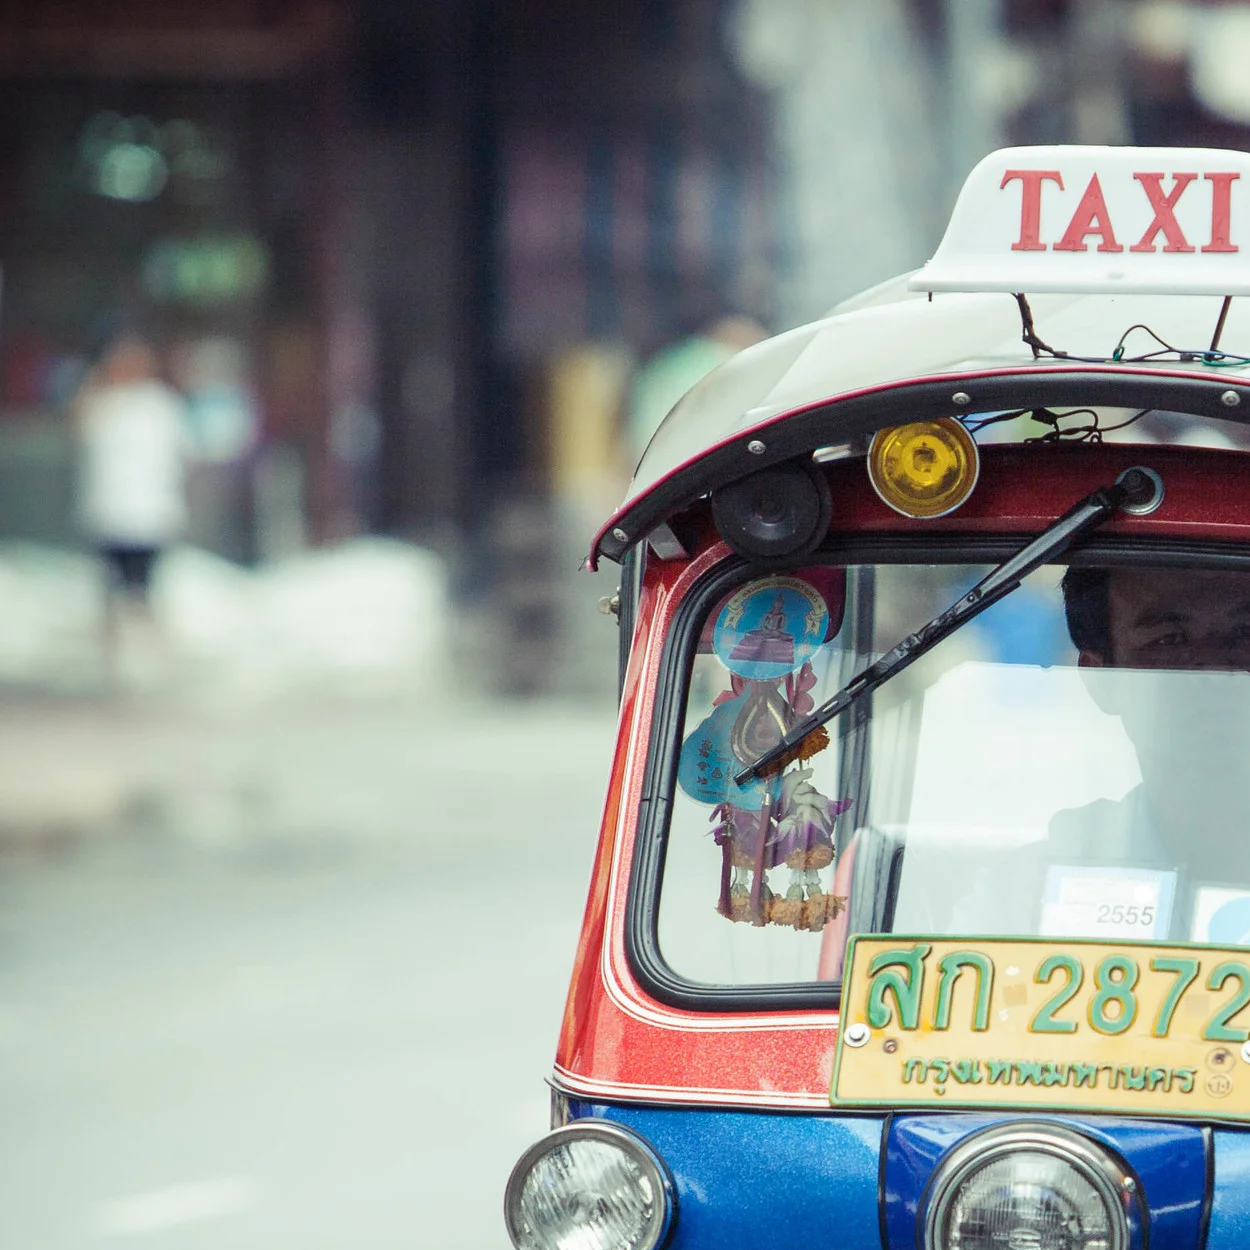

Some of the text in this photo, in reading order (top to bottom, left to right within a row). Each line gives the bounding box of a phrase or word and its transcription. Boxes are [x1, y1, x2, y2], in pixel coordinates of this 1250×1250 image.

[1000, 169, 1241, 253] TAXI
[1098, 904, 1154, 926] 2555
[867, 944, 995, 1031] สก
[903, 1057, 1197, 1095] กรุงเทพมหานคร
